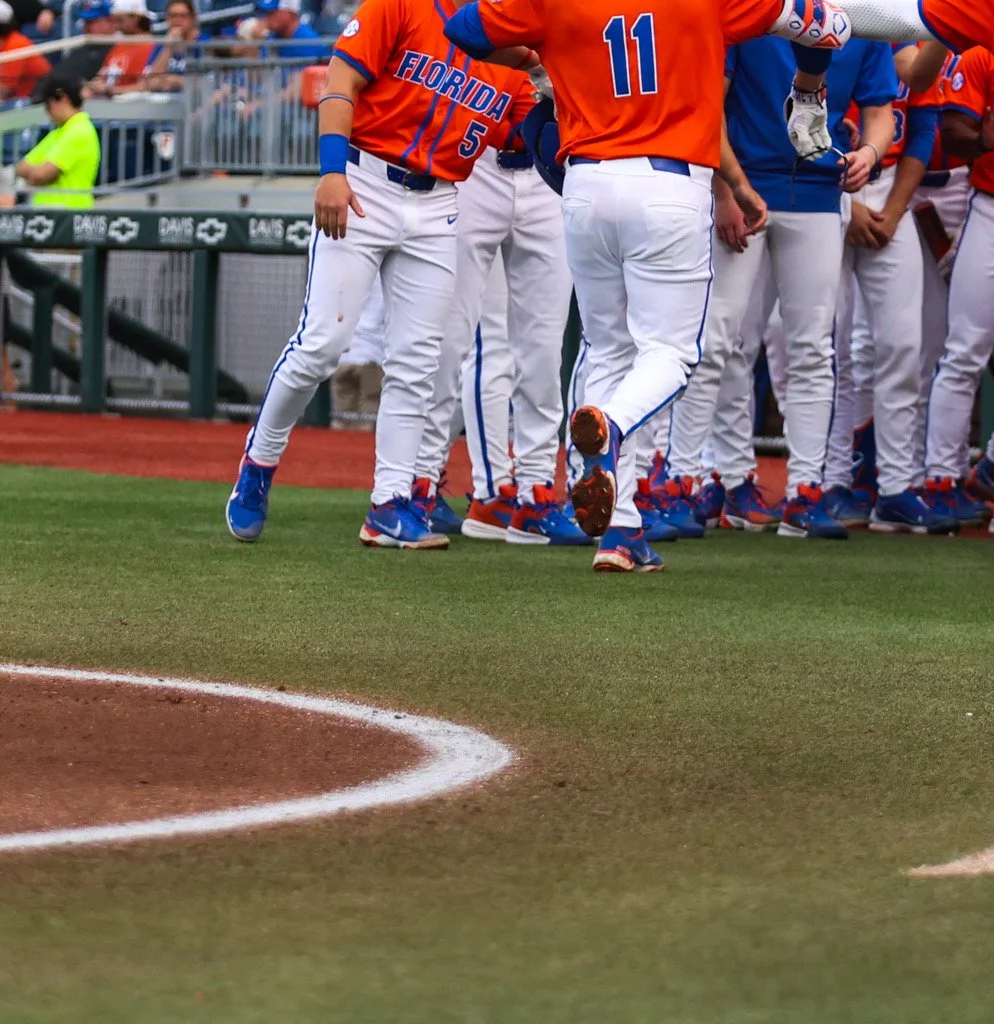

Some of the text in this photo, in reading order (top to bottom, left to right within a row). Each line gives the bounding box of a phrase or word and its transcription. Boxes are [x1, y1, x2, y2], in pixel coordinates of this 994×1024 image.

[602, 12, 659, 98] 11
[395, 49, 512, 124] FLORIDA
[458, 119, 489, 159] 5
[158, 216, 194, 236] DAVIS
[249, 217, 284, 238] DAVIS
